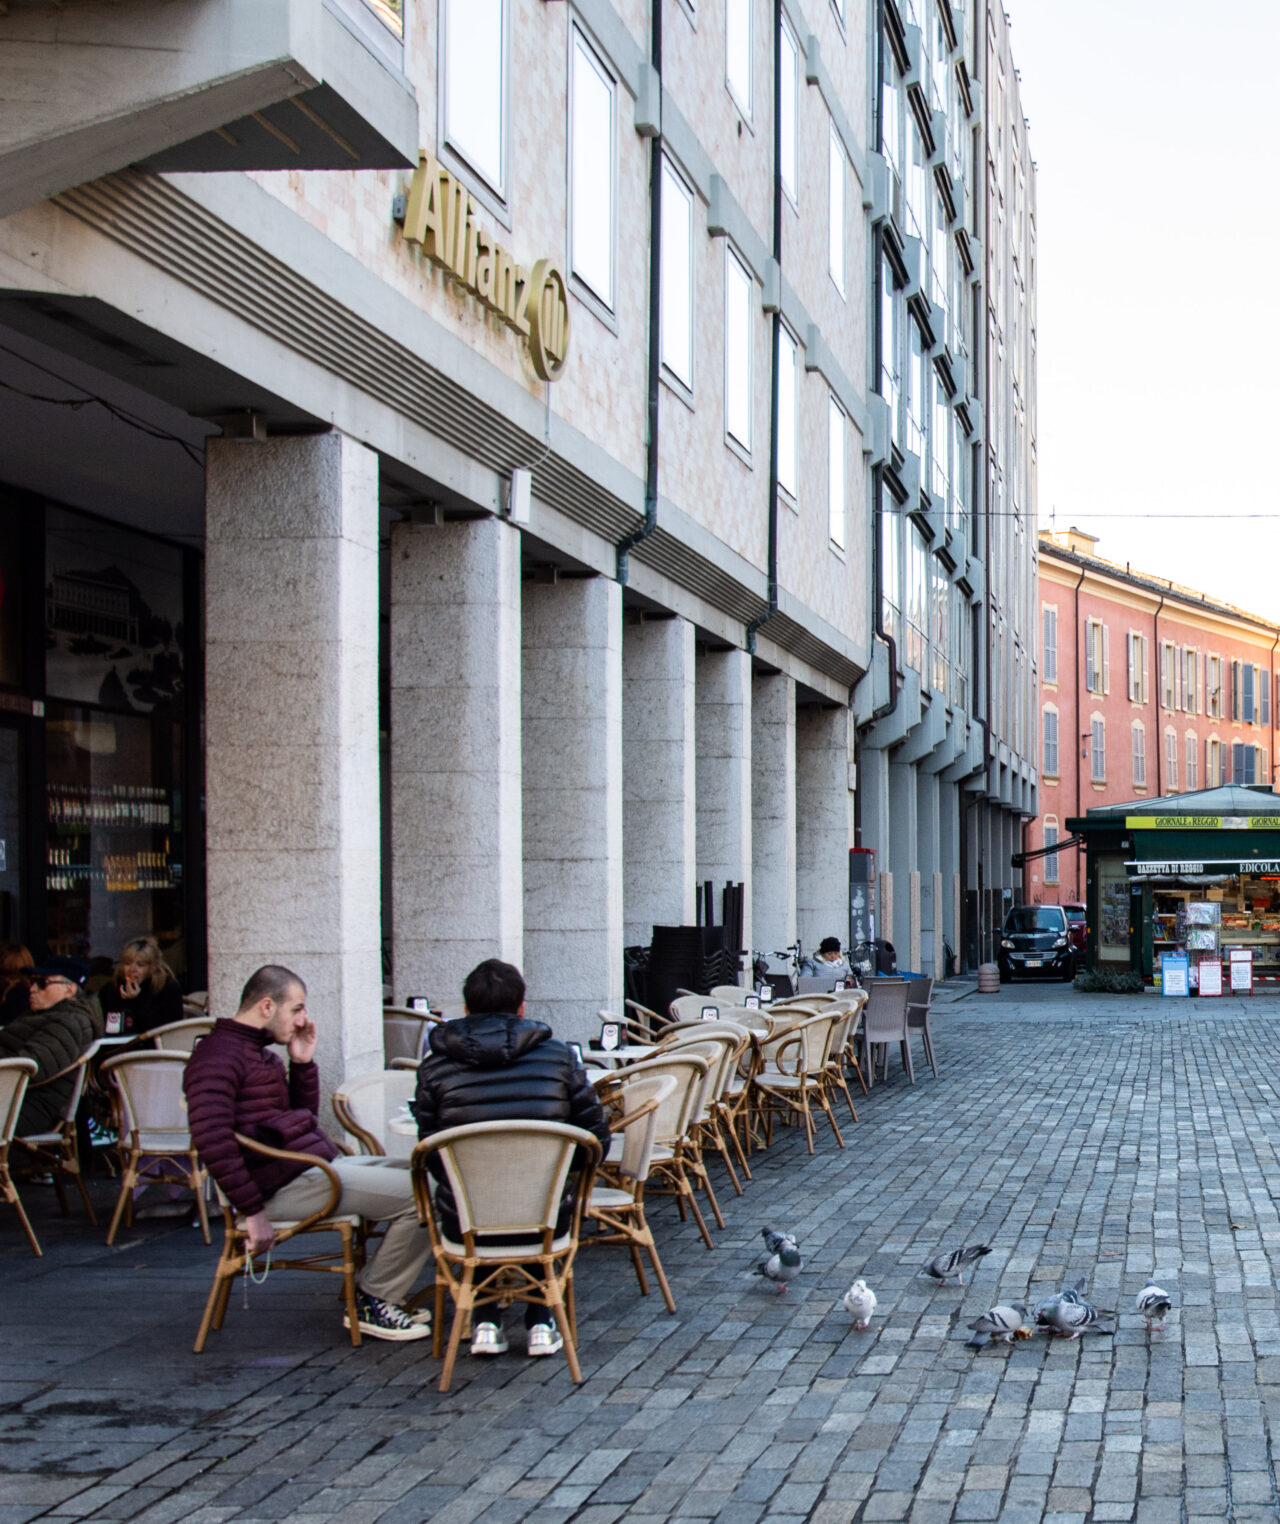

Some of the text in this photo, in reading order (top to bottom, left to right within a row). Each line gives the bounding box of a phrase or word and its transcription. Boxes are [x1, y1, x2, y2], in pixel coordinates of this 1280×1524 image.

[403, 149, 531, 337] Allianz
[1192, 816, 1219, 826] REGGIO
[1240, 862, 1280, 873] EDICOLA
